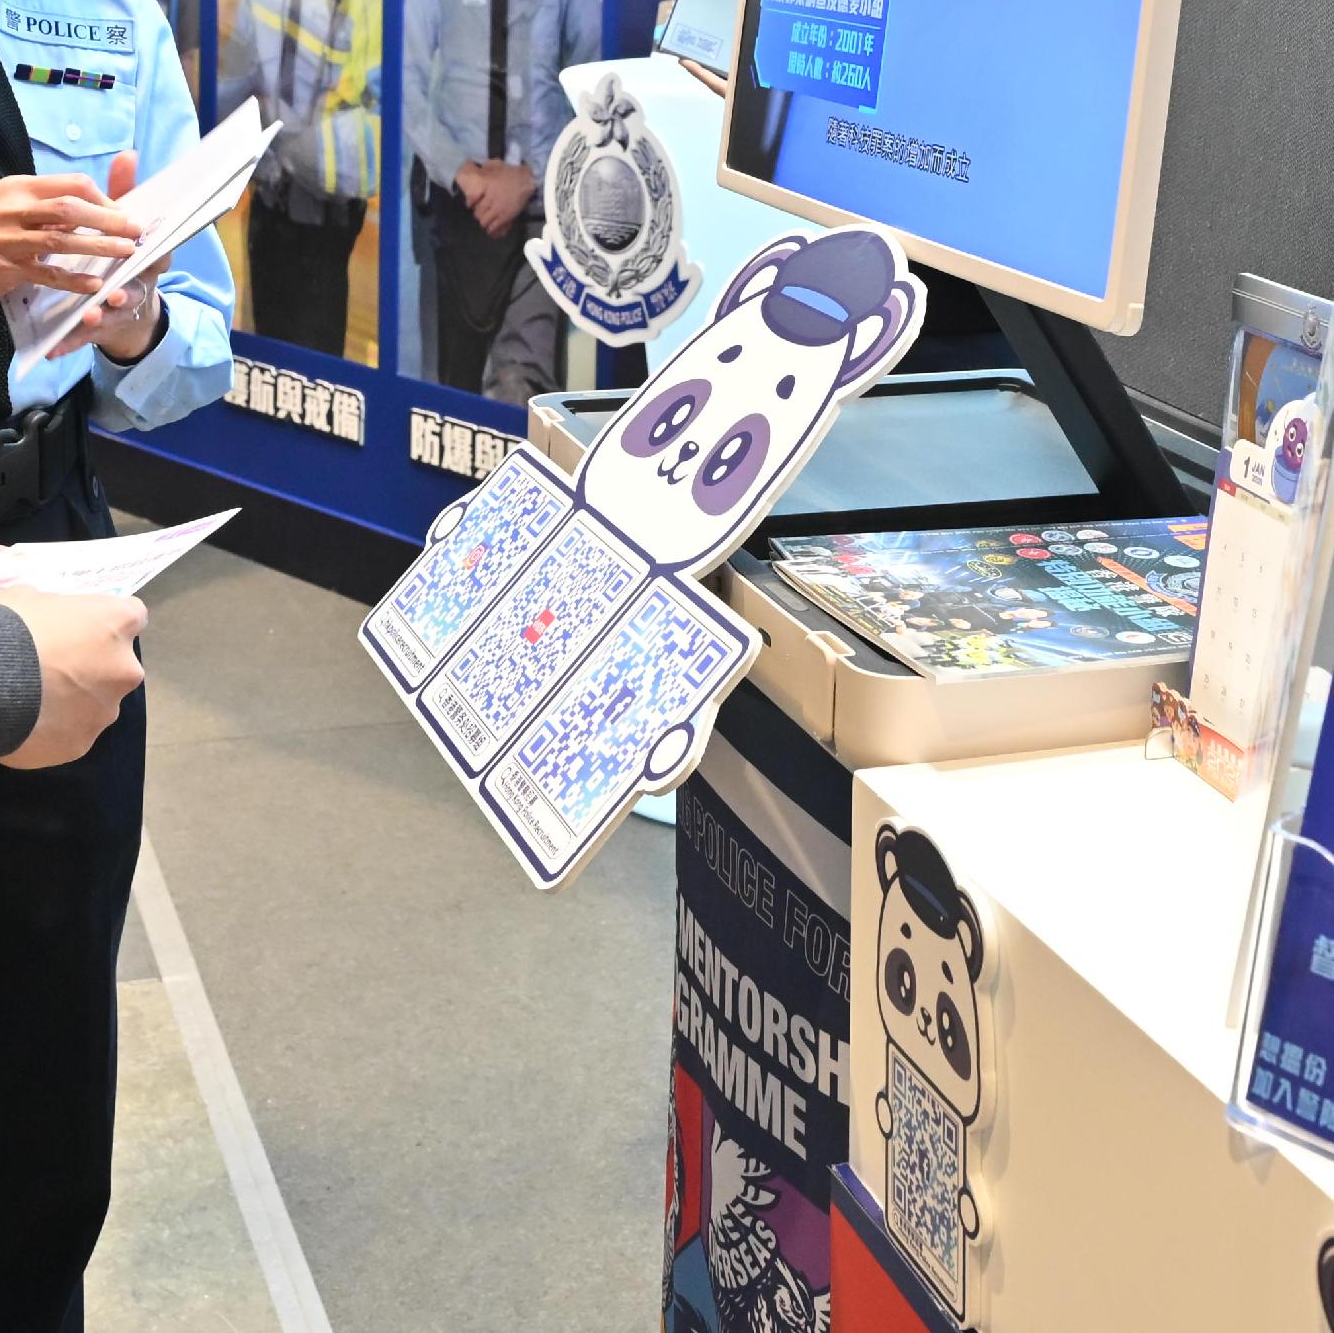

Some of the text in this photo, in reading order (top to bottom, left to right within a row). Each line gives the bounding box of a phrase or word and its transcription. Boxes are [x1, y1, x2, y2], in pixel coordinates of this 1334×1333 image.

[6, 8, 127, 45] 警 POLICE 察
[826, 116, 971, 183] 隨著科技罪案的增加而成立
[1243, 456, 1265, 479] 1 JAN
[694, 797, 775, 929] POLICE
